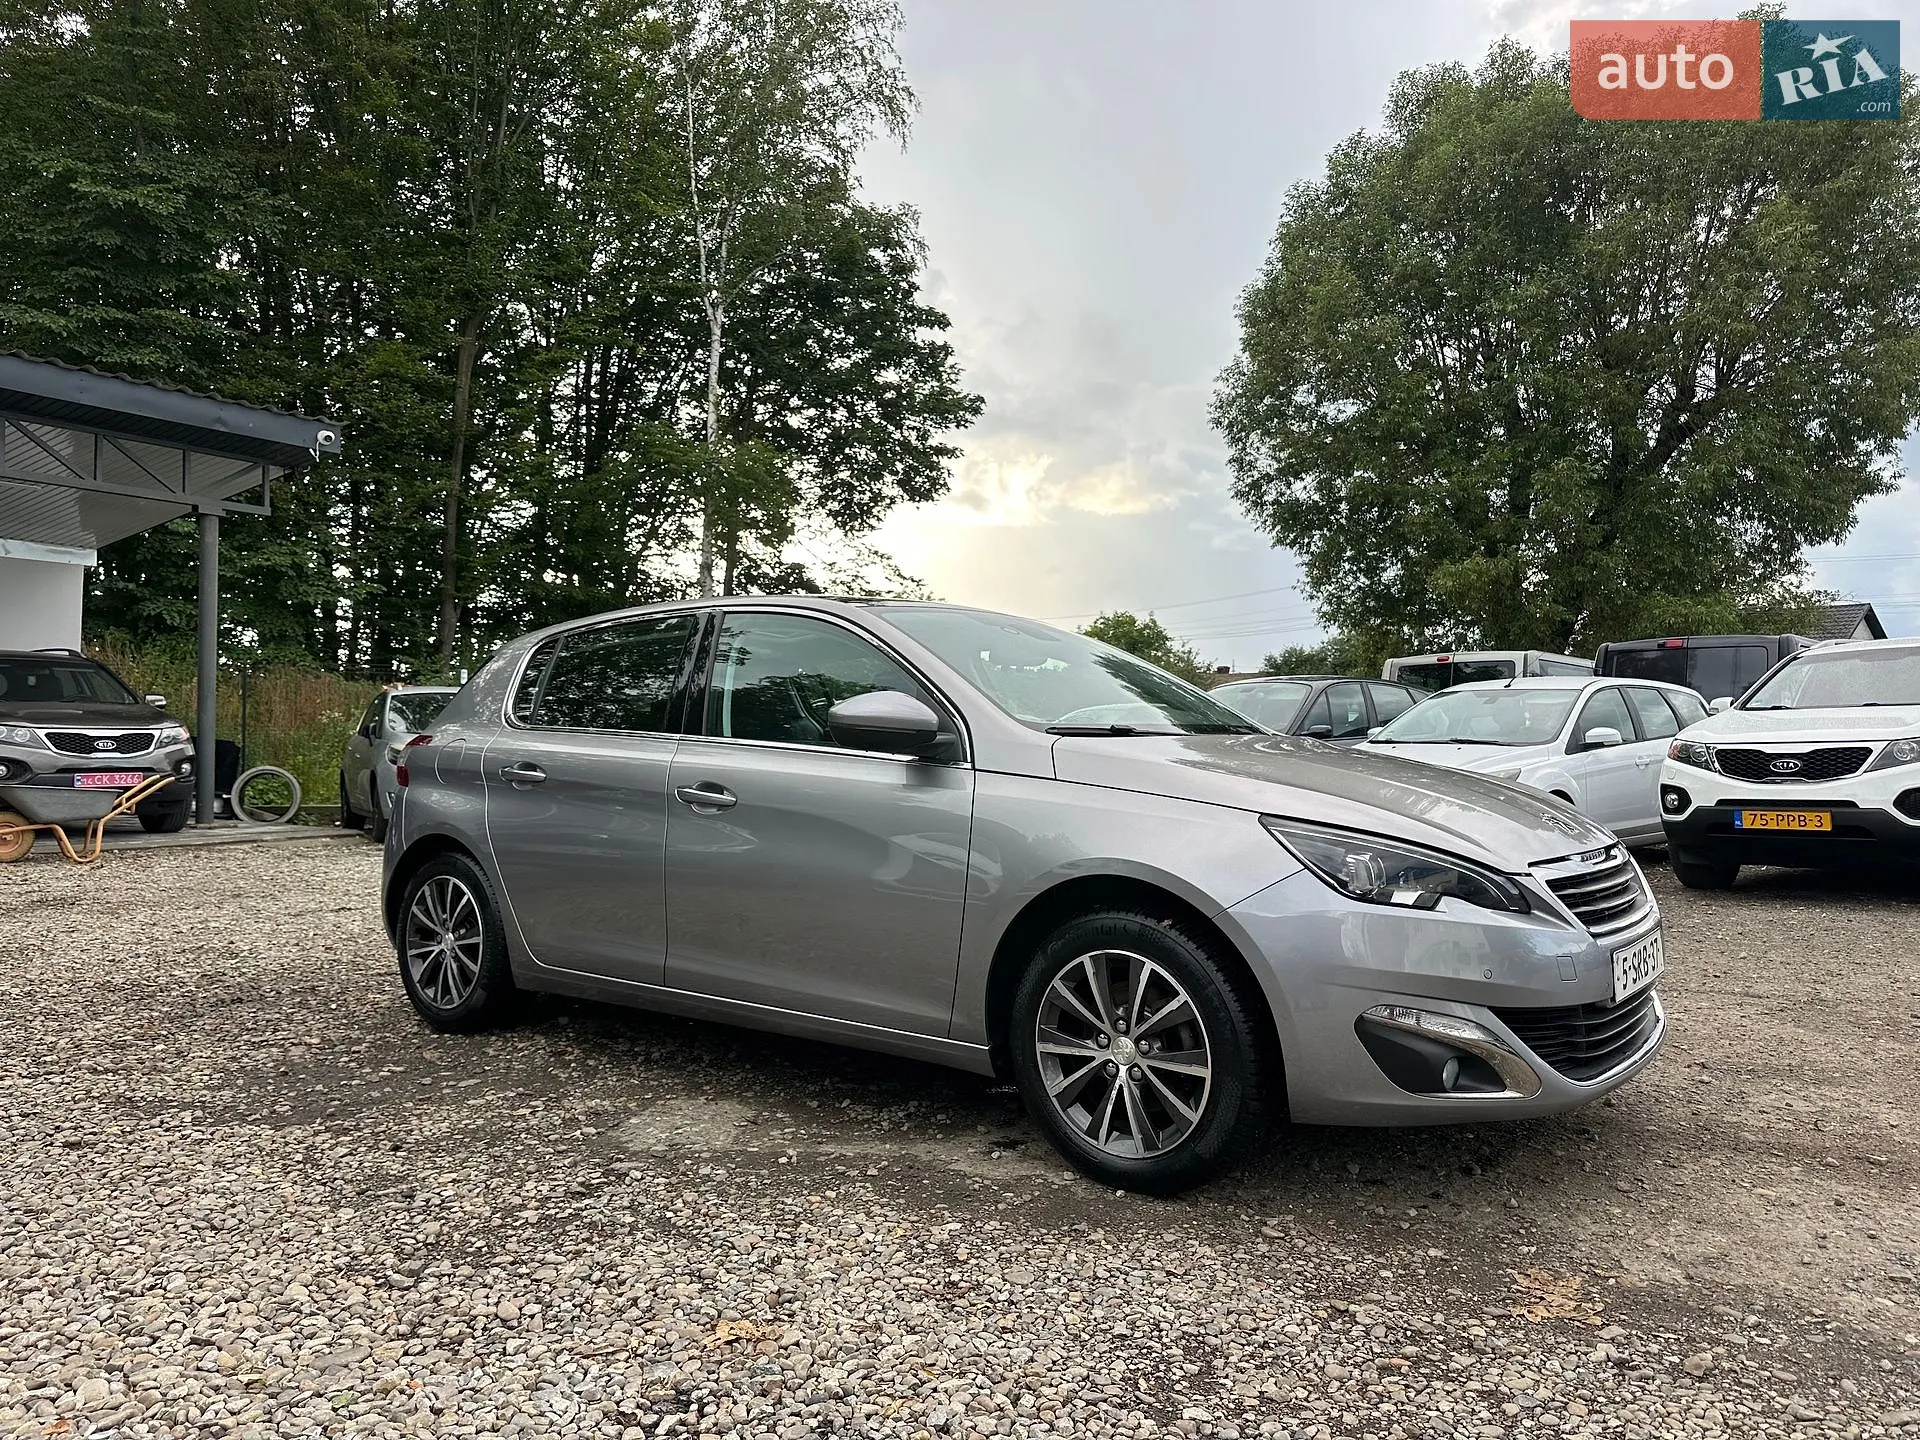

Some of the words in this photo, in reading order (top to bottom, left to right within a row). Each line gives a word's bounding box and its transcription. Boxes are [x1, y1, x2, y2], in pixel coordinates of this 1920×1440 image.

[113, 774, 139, 785] 3266
[1748, 813, 1824, 828] 75-PPB-3
[1622, 937, 1659, 991] 5-SRB-37
